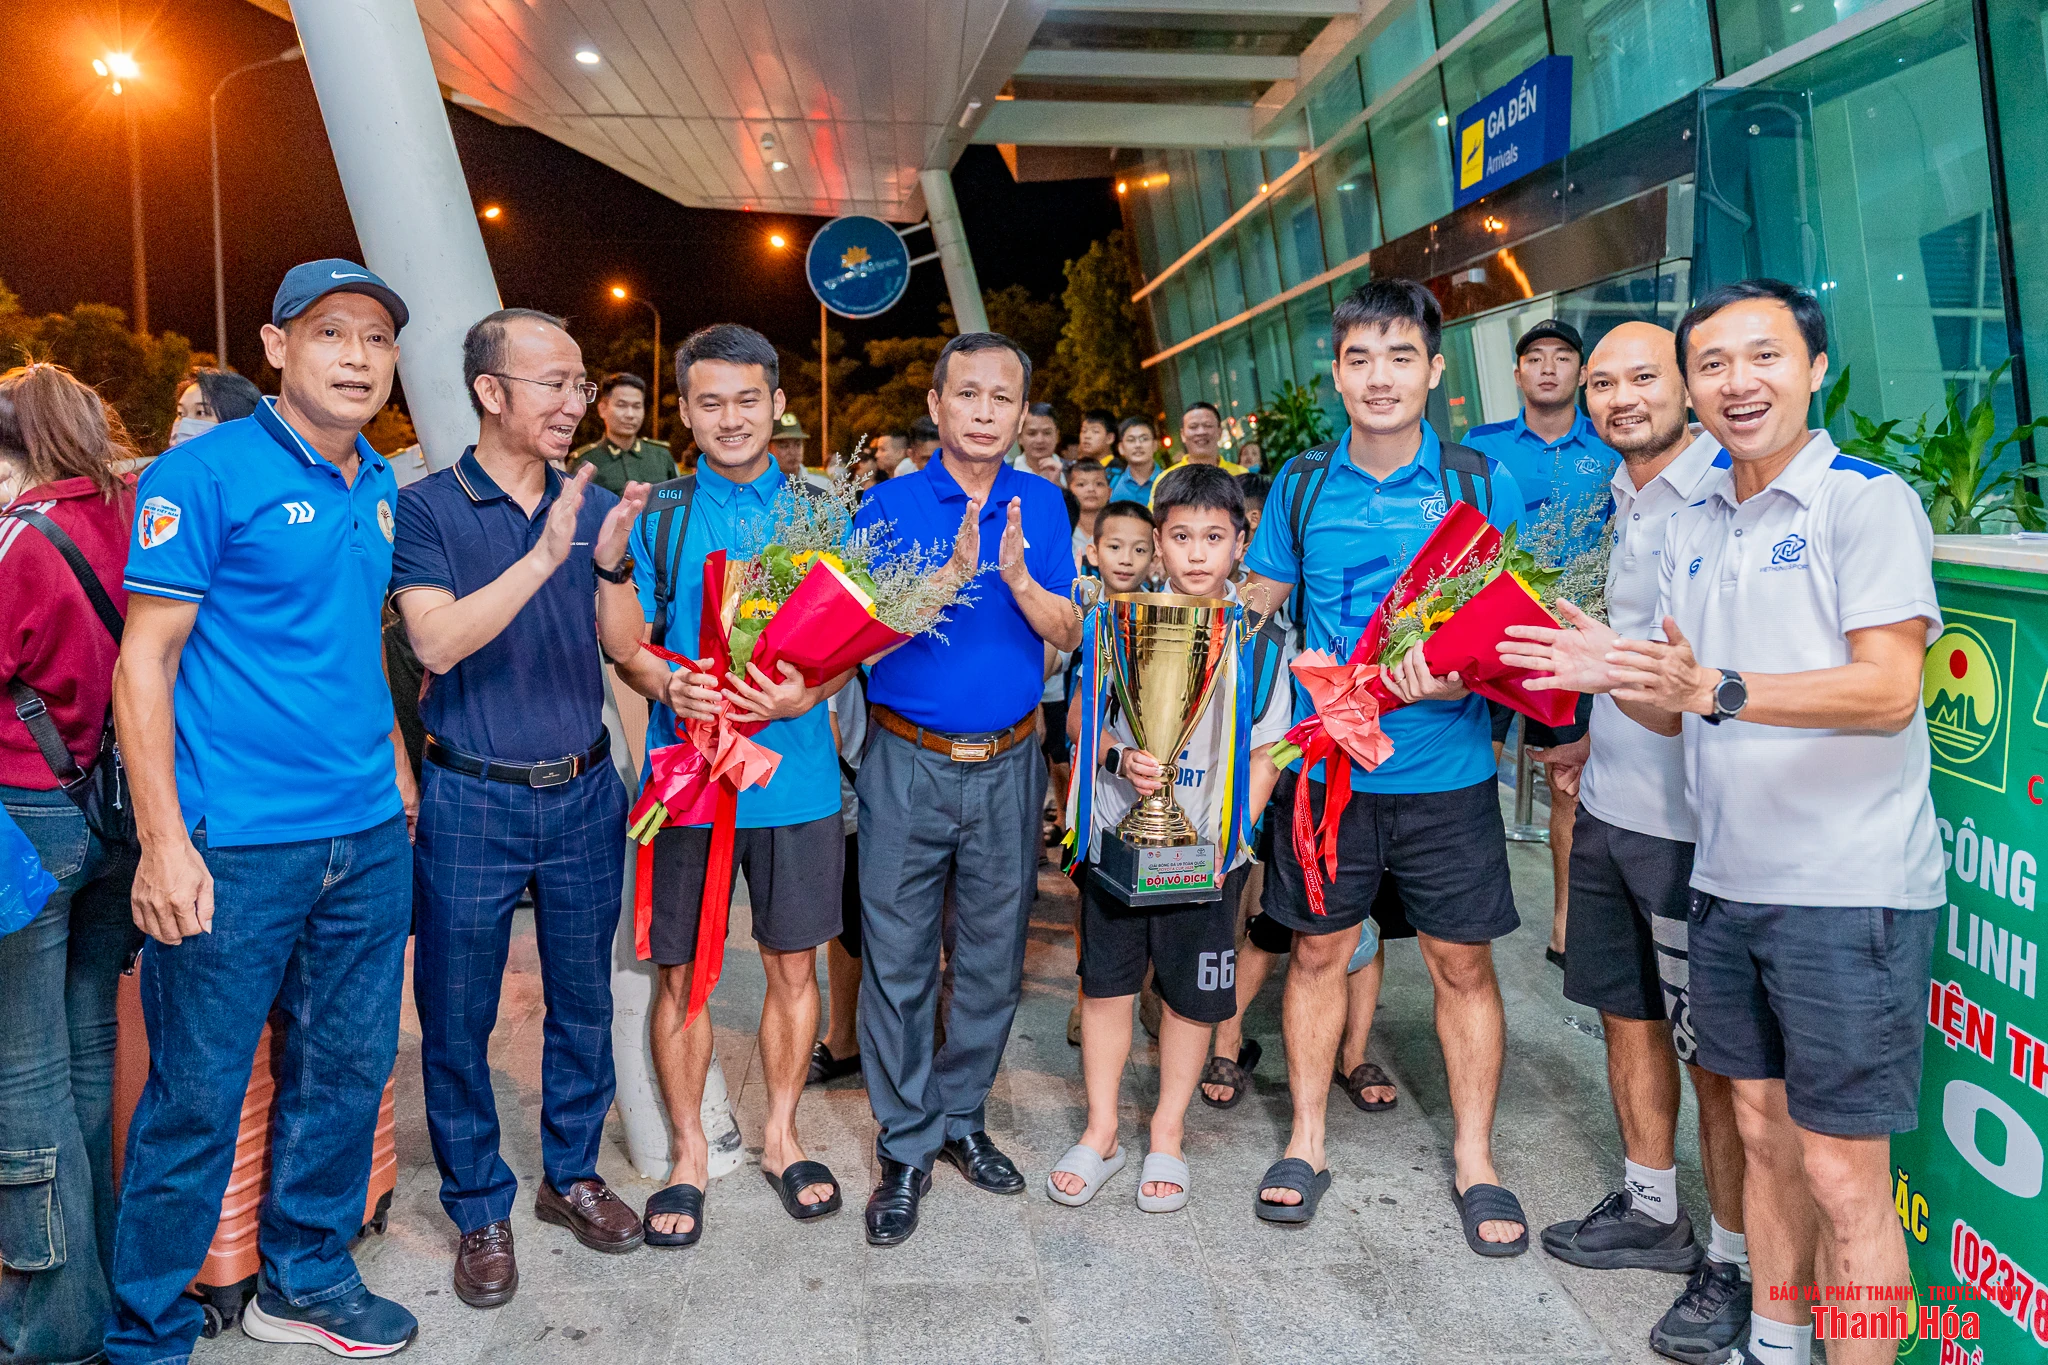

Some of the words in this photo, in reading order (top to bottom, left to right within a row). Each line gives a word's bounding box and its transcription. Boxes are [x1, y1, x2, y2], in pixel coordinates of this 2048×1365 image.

[1487, 106, 1506, 139] GA
[1508, 79, 1538, 127] ĐẾN
[1486, 143, 1519, 177] Arrivals
[1305, 450, 1328, 461] GIGI
[658, 489, 682, 499] GIGI
[1147, 874, 1164, 887] ĐỘI
[1167, 873, 1181, 884] VÔ
[1184, 873, 1207, 885] ĐỊCH
[1197, 949, 1235, 991] 66
[1948, 903, 2038, 999] LINH
[1927, 978, 1997, 1064] IỆN
